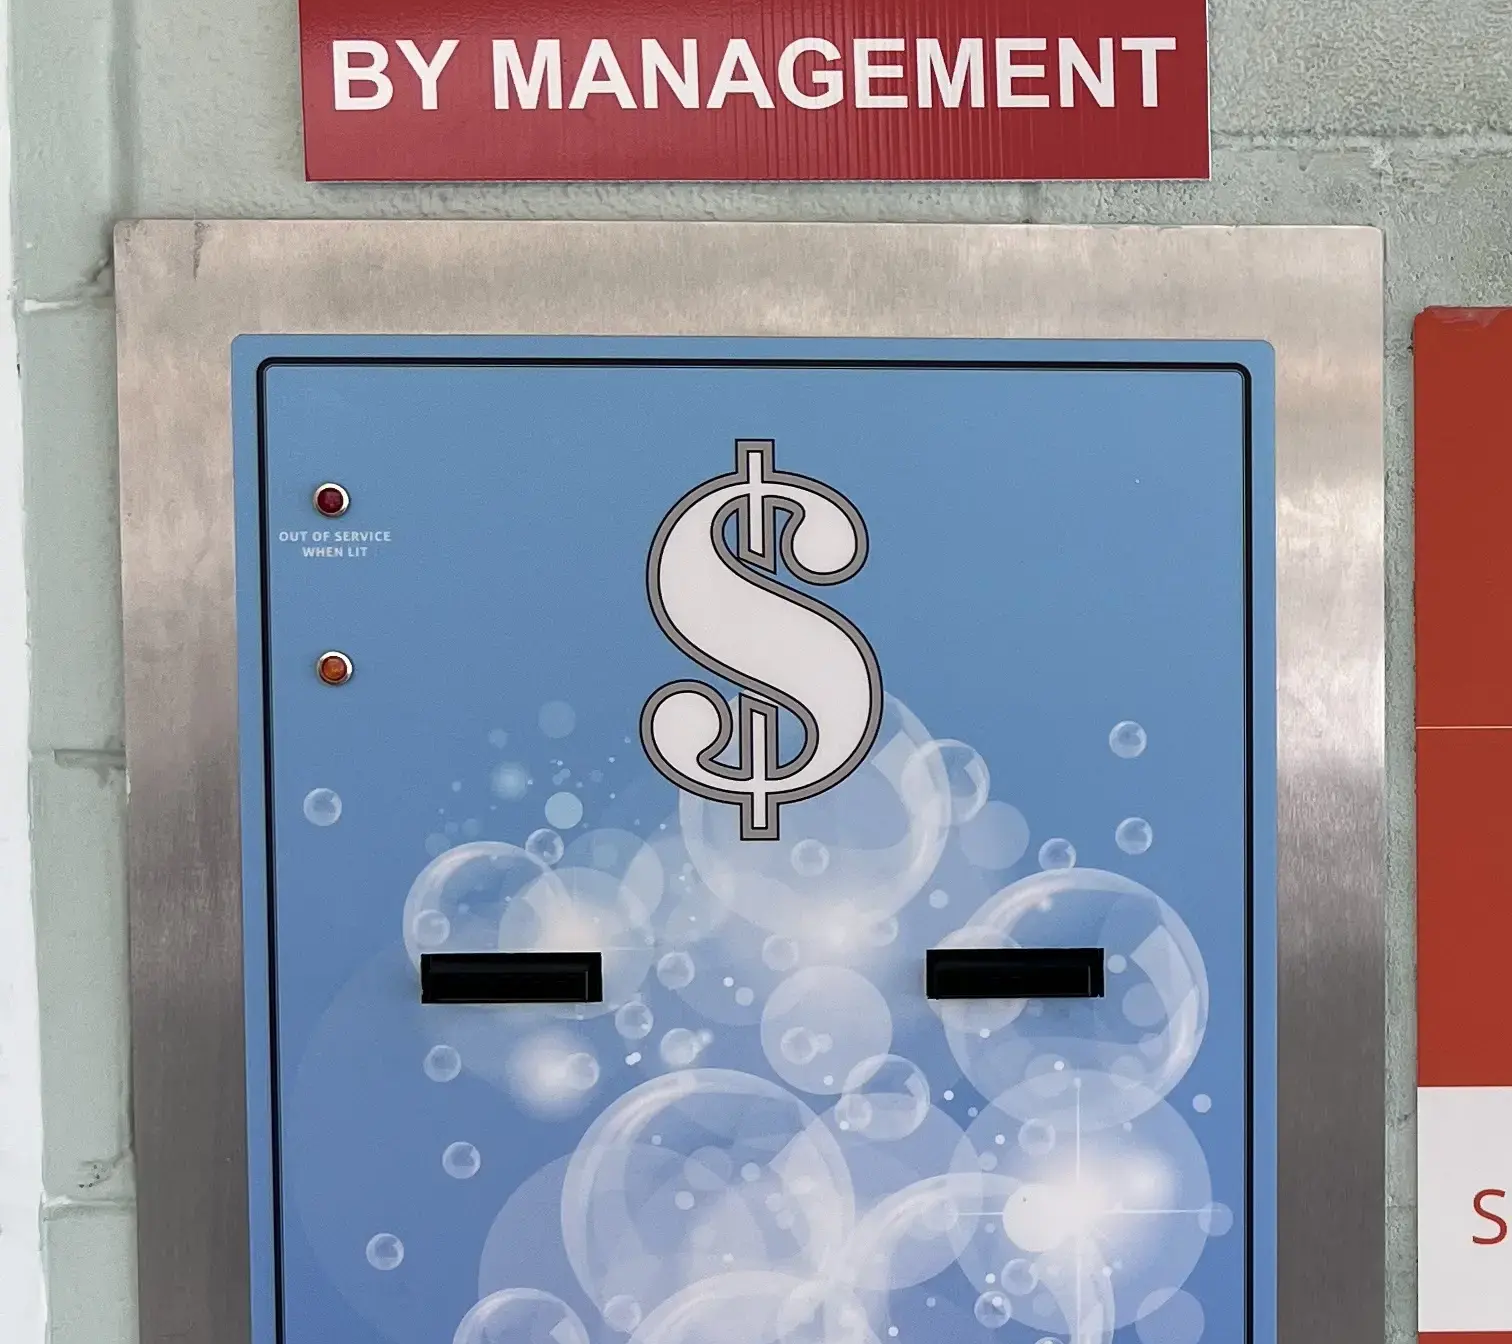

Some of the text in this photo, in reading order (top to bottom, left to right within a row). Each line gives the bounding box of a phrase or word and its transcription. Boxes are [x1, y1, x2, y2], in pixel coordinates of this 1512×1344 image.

[333, 36, 1176, 110] BY MANAGEMENT
[279, 531, 391, 541] OUT OF SERVICE
[302, 547, 367, 557] WHEN LIT
[639, 438, 884, 841] $
